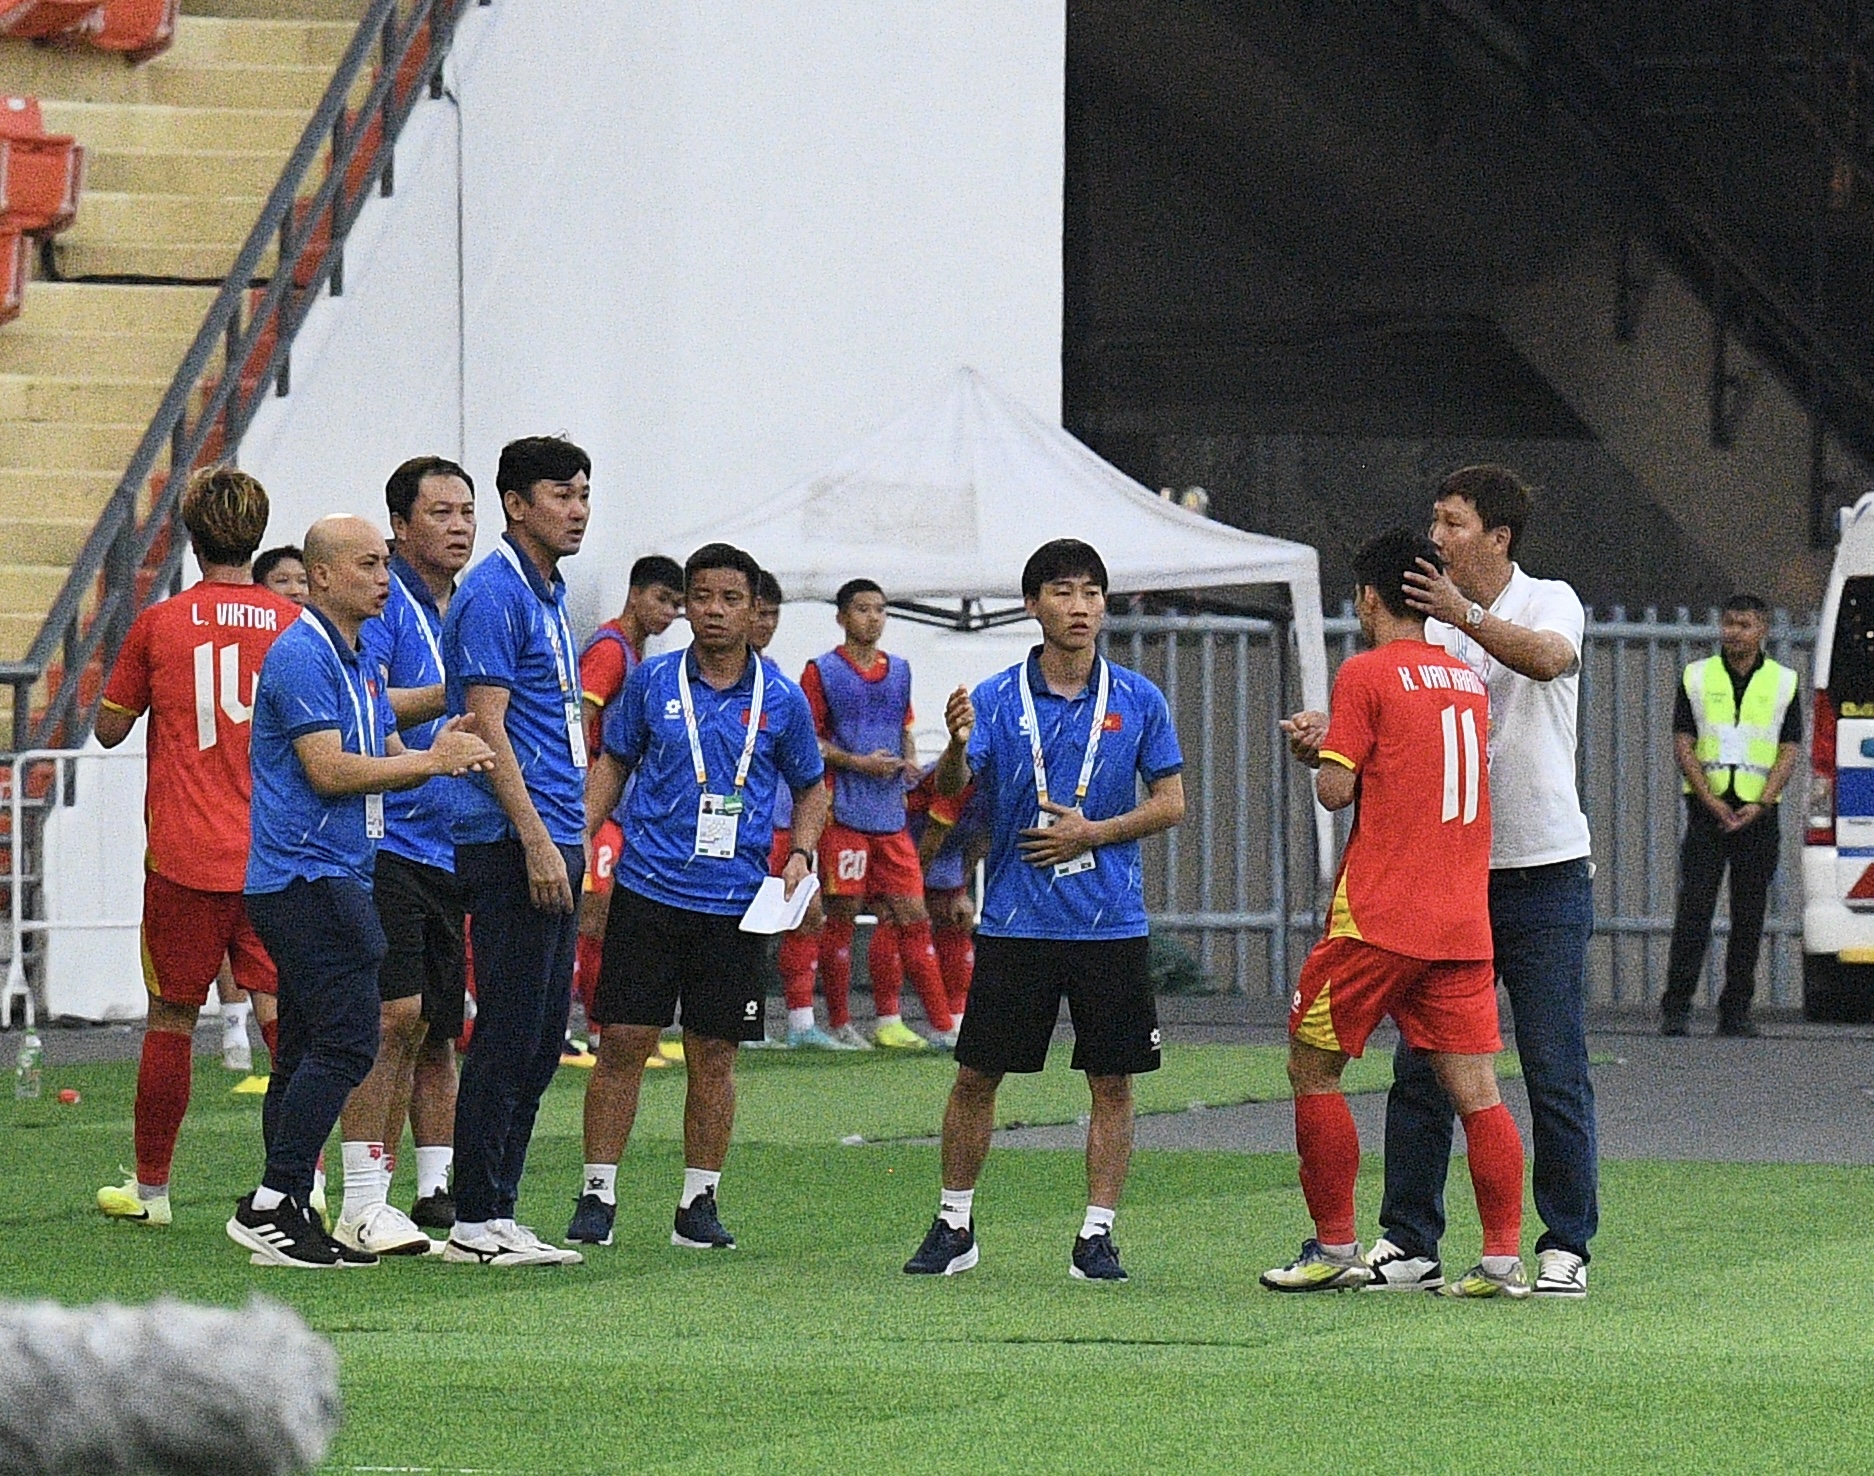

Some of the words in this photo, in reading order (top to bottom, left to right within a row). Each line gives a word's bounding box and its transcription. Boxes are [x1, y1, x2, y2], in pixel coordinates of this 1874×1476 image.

[191, 603, 210, 626] L.
[216, 602, 277, 632] VIKTOR
[1397, 665, 1420, 692] K.
[1417, 664, 1452, 690] VAN
[1440, 704, 1480, 826] 11
[837, 848, 868, 881] 20
